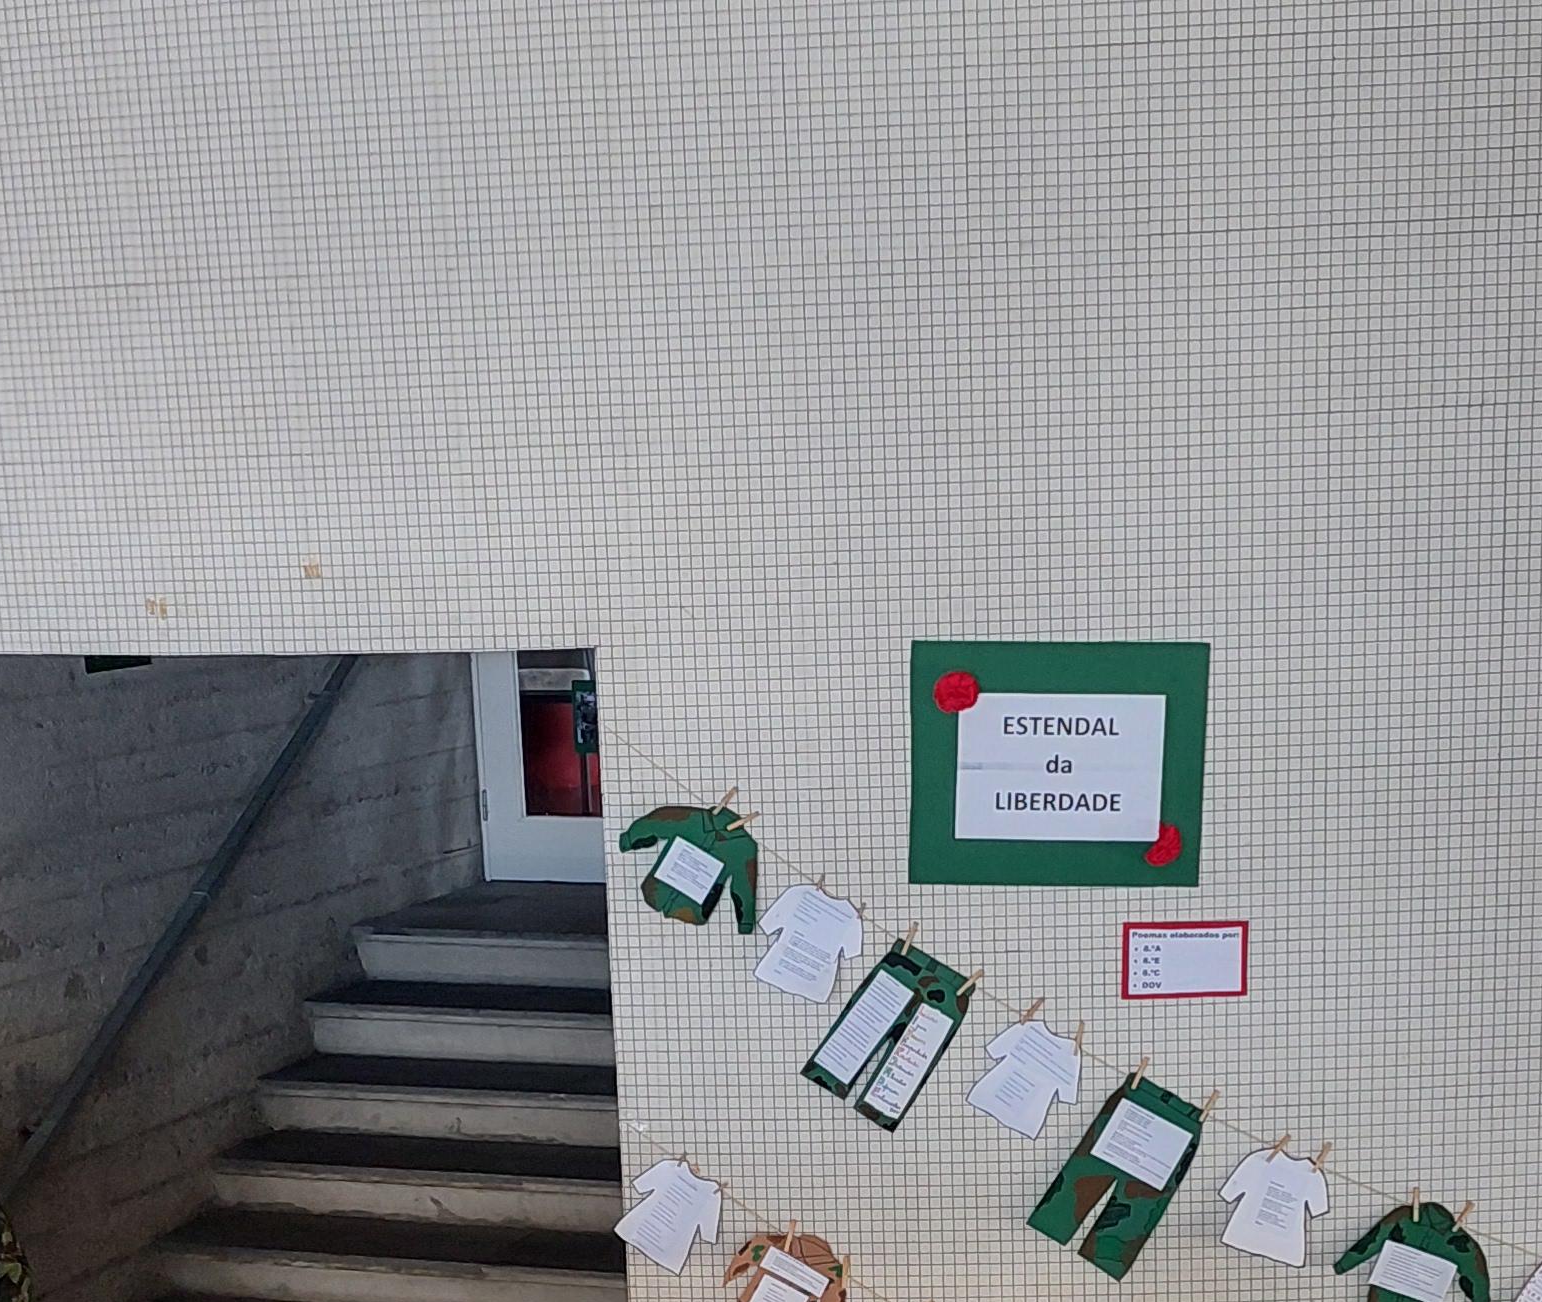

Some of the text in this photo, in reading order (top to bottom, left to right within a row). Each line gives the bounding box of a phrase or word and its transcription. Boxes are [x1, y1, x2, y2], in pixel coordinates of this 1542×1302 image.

[1003, 716, 1120, 736] ESTENDAL
[1046, 754, 1072, 774] da
[995, 792, 1121, 812] LIBERDADE
[1170, 931, 1219, 939] elaborados
[1142, 981, 1162, 989] DOV
